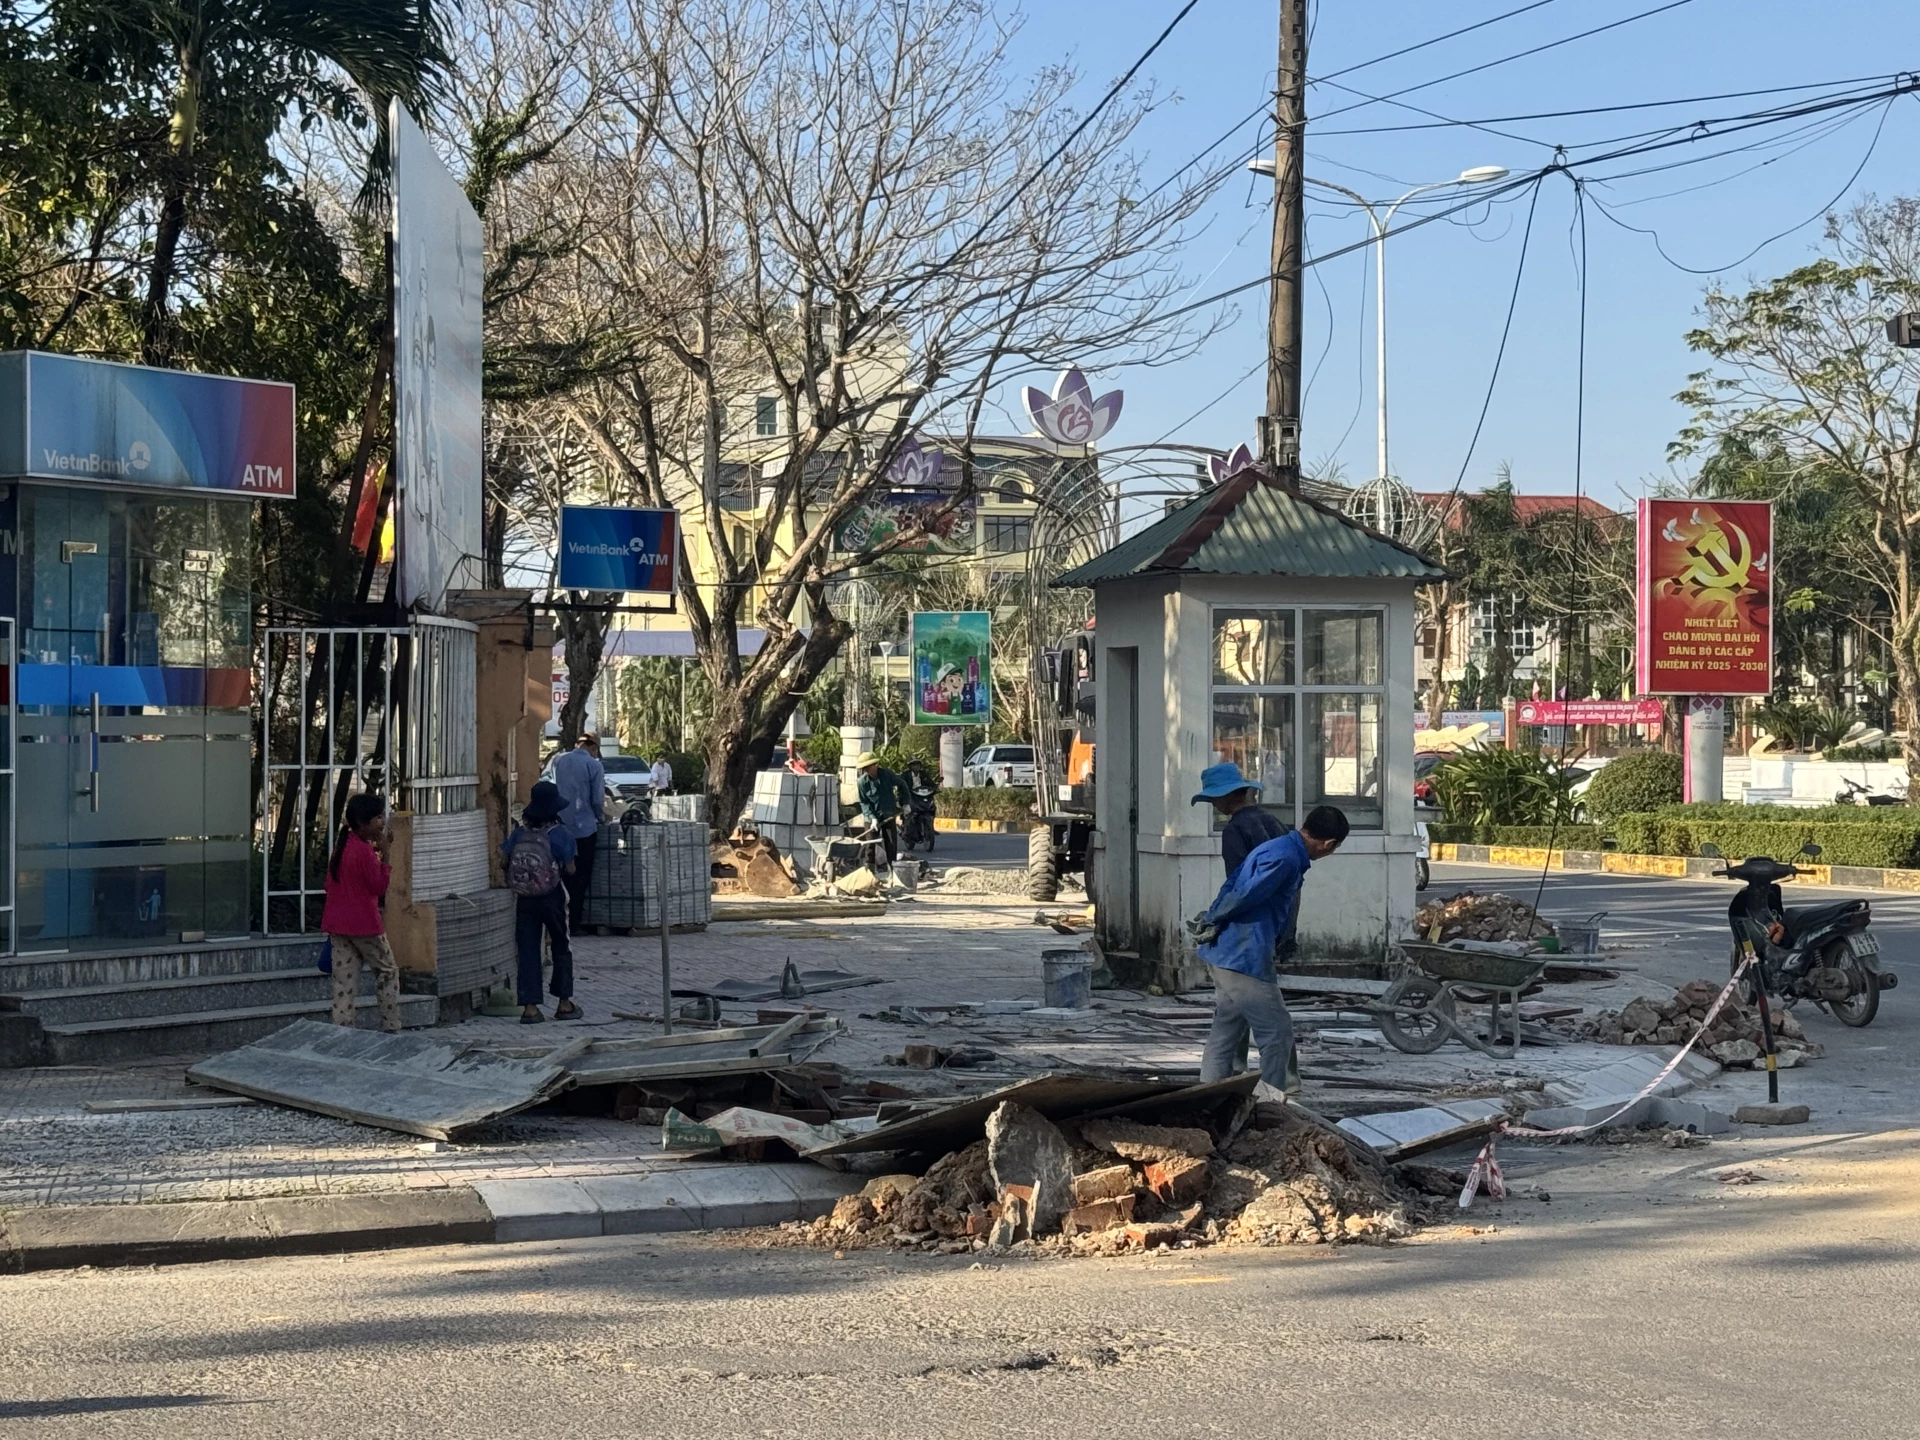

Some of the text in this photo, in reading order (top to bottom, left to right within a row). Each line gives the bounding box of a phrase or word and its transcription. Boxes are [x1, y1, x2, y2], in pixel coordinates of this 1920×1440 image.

[43, 448, 132, 476] VietinBank
[242, 464, 284, 489] ATM
[568, 541, 630, 556] VietinBank
[638, 553, 668, 566] ATM
[1707, 661, 1731, 671] 2025
[1739, 661, 1767, 672] 2030!
